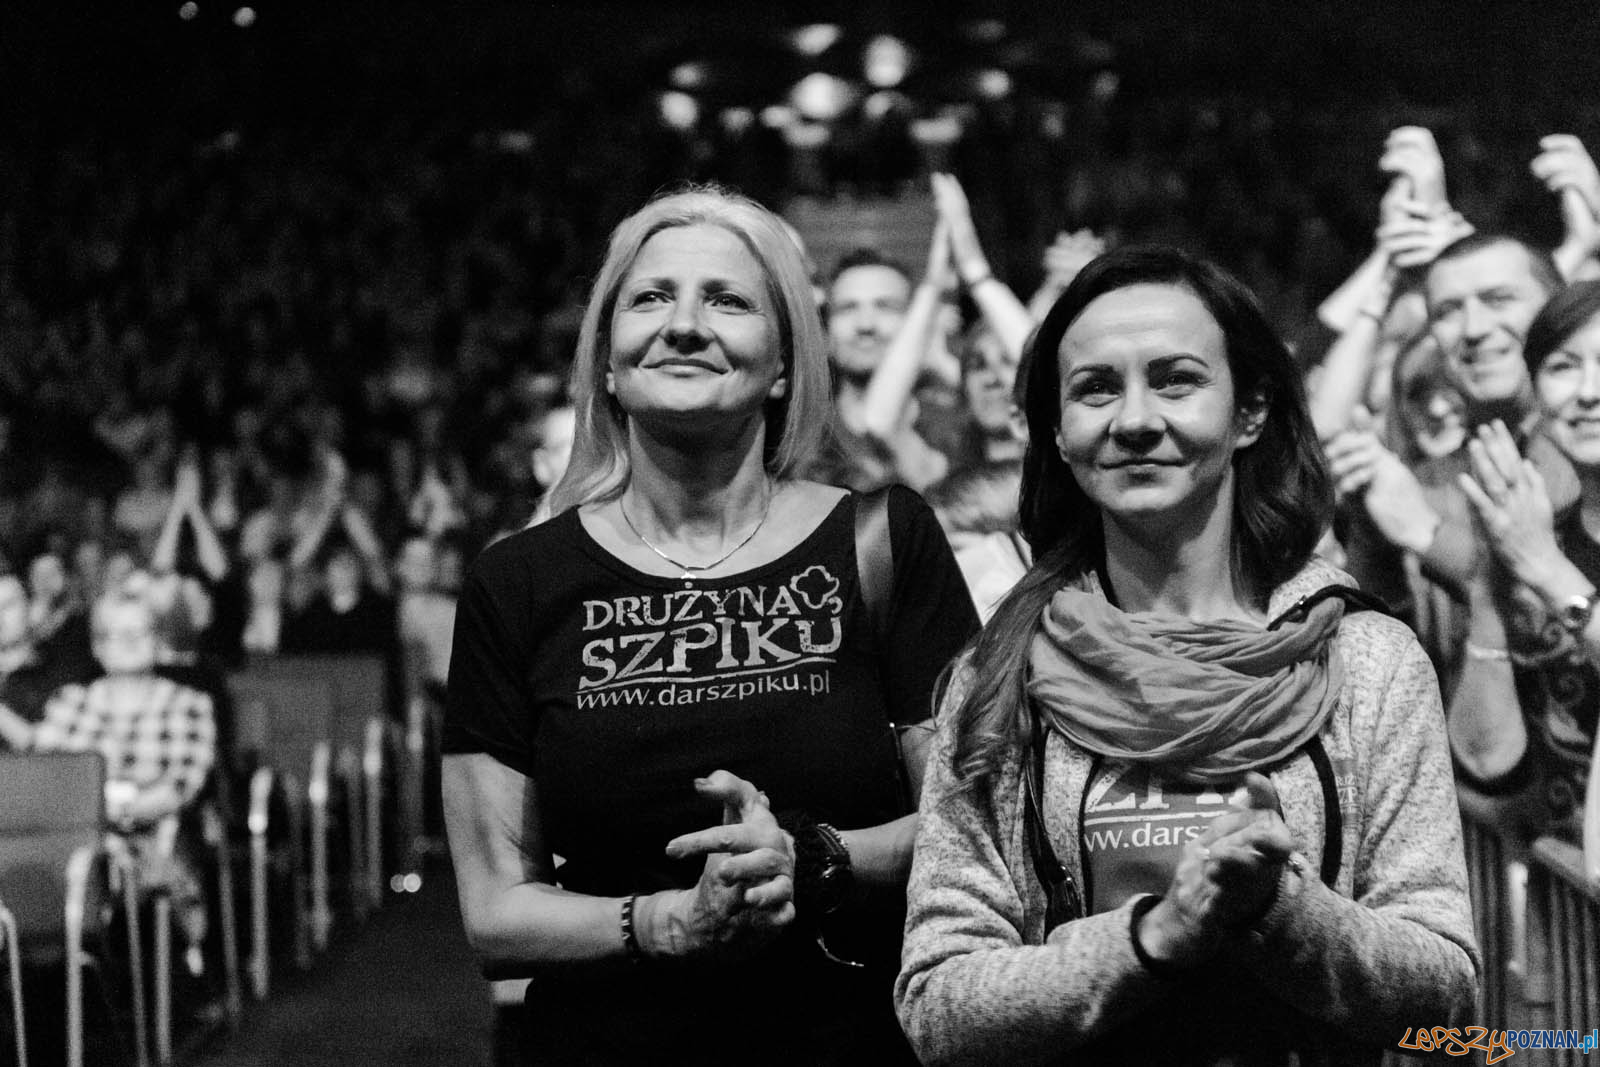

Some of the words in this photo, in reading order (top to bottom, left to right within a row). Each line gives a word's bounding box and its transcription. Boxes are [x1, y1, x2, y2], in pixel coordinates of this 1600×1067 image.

[582, 581, 801, 631] DRUŻYNA
[578, 616, 842, 690] SZPIKU
[576, 670, 830, 710] www.darszpiku.pl
